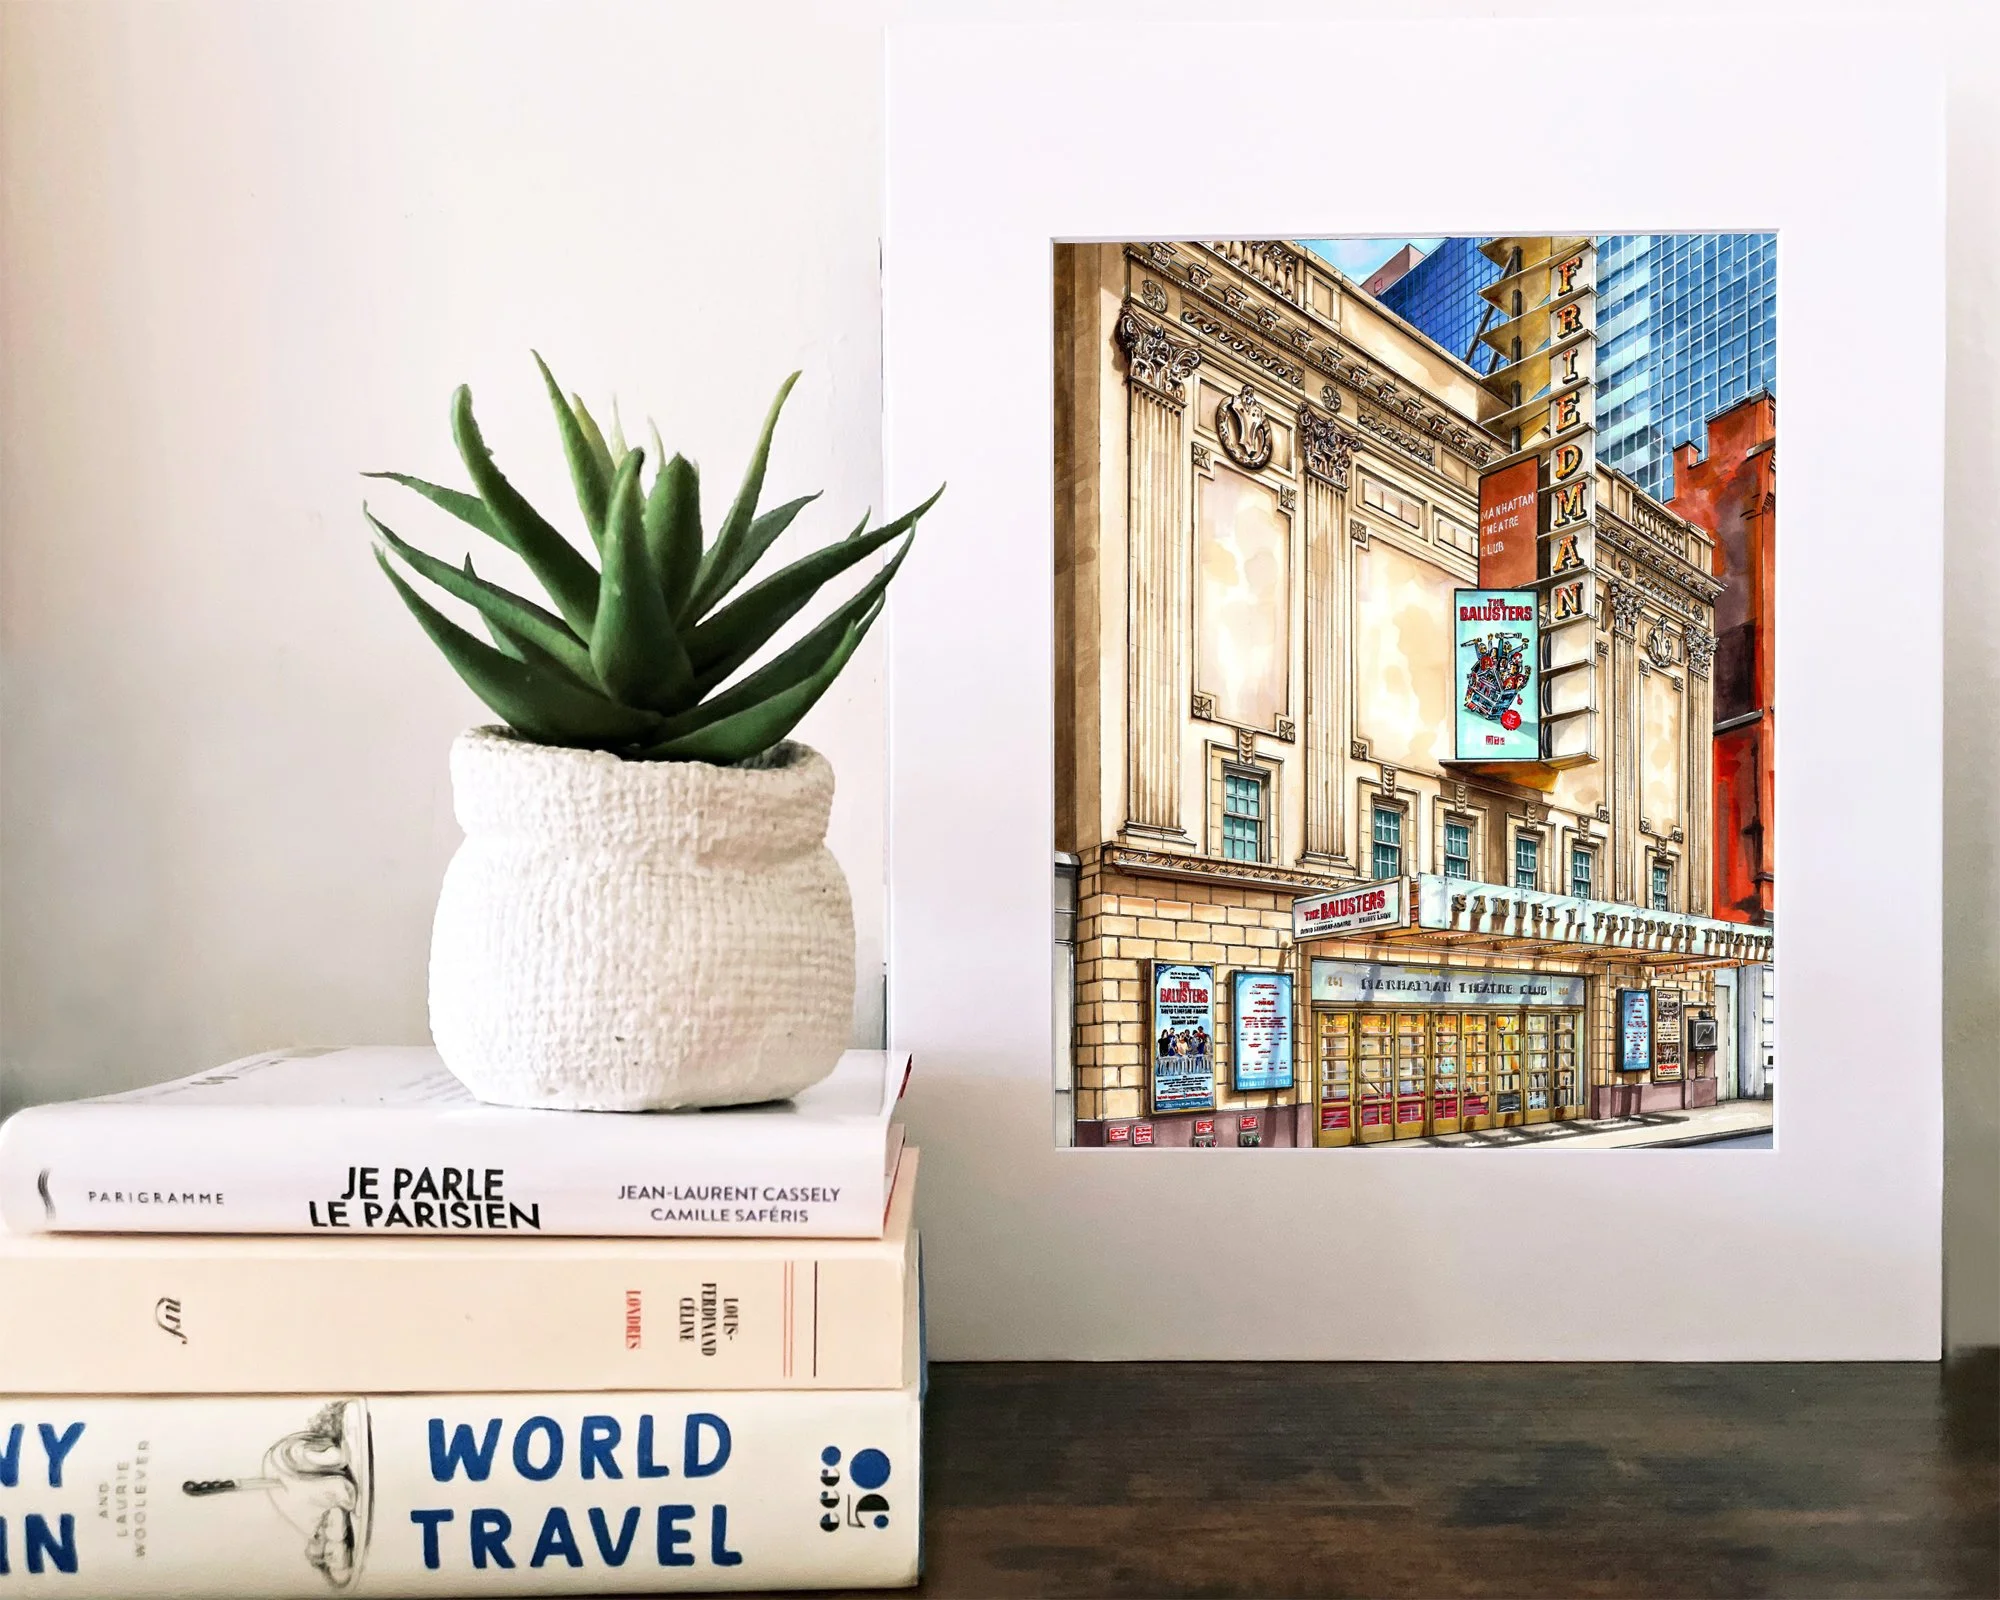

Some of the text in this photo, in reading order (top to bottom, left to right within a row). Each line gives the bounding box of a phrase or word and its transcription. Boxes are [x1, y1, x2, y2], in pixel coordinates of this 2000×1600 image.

[1553, 255, 1588, 621] FRIEDMAN
[1481, 491, 1535, 522] MANHATTAN
[1481, 515, 1520, 537] THEATRE
[1481, 541, 1505, 558] CLUB
[1459, 605, 1533, 622] BALUSTERS
[1487, 598, 1506, 607] THE
[1303, 889, 1386, 921] THE BALUSTERS
[1451, 893, 1560, 924] SAMUEL
[1592, 911, 1697, 941] FRIEDMAN
[1160, 987, 1209, 1004] BALUSTERS
[88, 1190, 225, 1205] PARIGRAMME
[341, 1166, 504, 1201] JE PARLE
[617, 1185, 841, 1204] JEAN-LAURENT CASSELY
[309, 1200, 541, 1230] LE PARISIEN
[650, 1205, 809, 1224] CAMILLE SAFÉRIS
[625, 1289, 642, 1350] LONDRES
[679, 1296, 699, 1342] CÉLINE
[700, 1282, 717, 1356] FERDINAND
[722, 1296, 739, 1341] LOUIS-
[428, 1412, 732, 1482] WORLD
[98, 1482, 109, 1519] AND
[115, 1461, 129, 1538] LAURIE
[133, 1440, 150, 1559] WOOLEVER
[410, 1503, 743, 1569] TRAVEL
